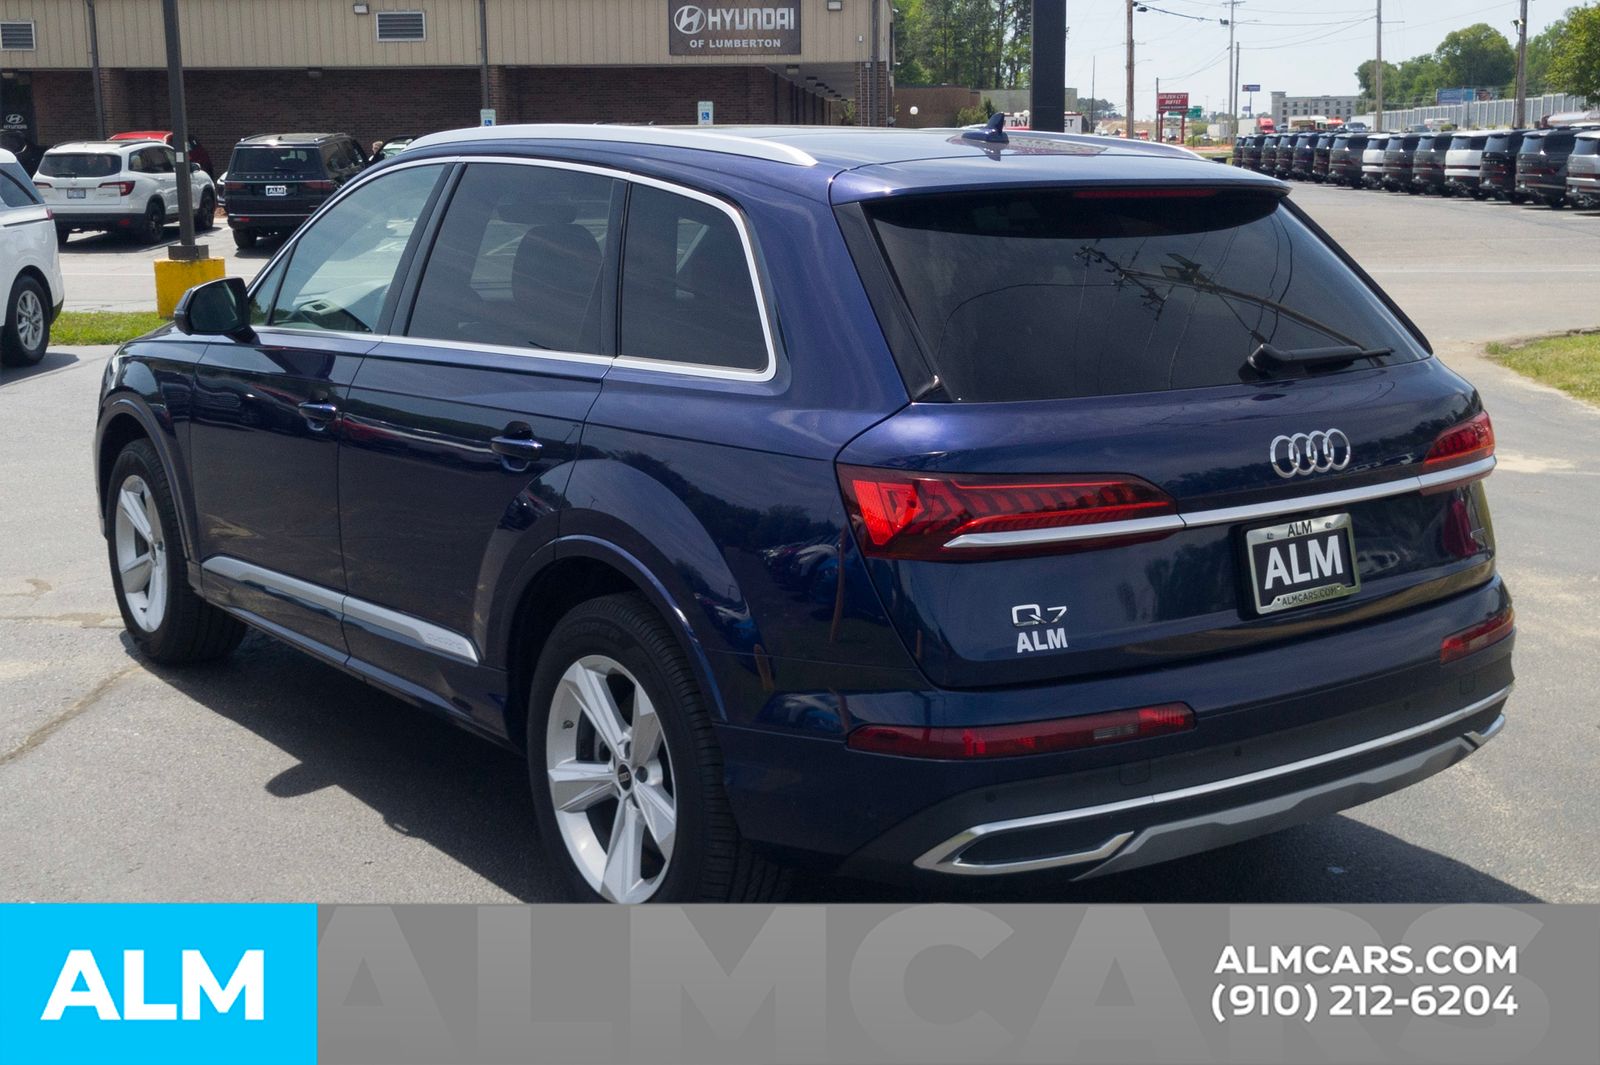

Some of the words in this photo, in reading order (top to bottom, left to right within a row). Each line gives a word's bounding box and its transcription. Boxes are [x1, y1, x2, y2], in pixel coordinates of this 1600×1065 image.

[708, 8, 795, 31] HYUNDAI
[689, 39, 705, 48] OF
[709, 39, 781, 48] LUMBERTON
[1287, 520, 1313, 538] ALM
[1264, 534, 1344, 590] ALM
[1281, 587, 1338, 607] ALMCARS.COM
[1011, 603, 1067, 627] Q7
[1016, 627, 1069, 654] ALM
